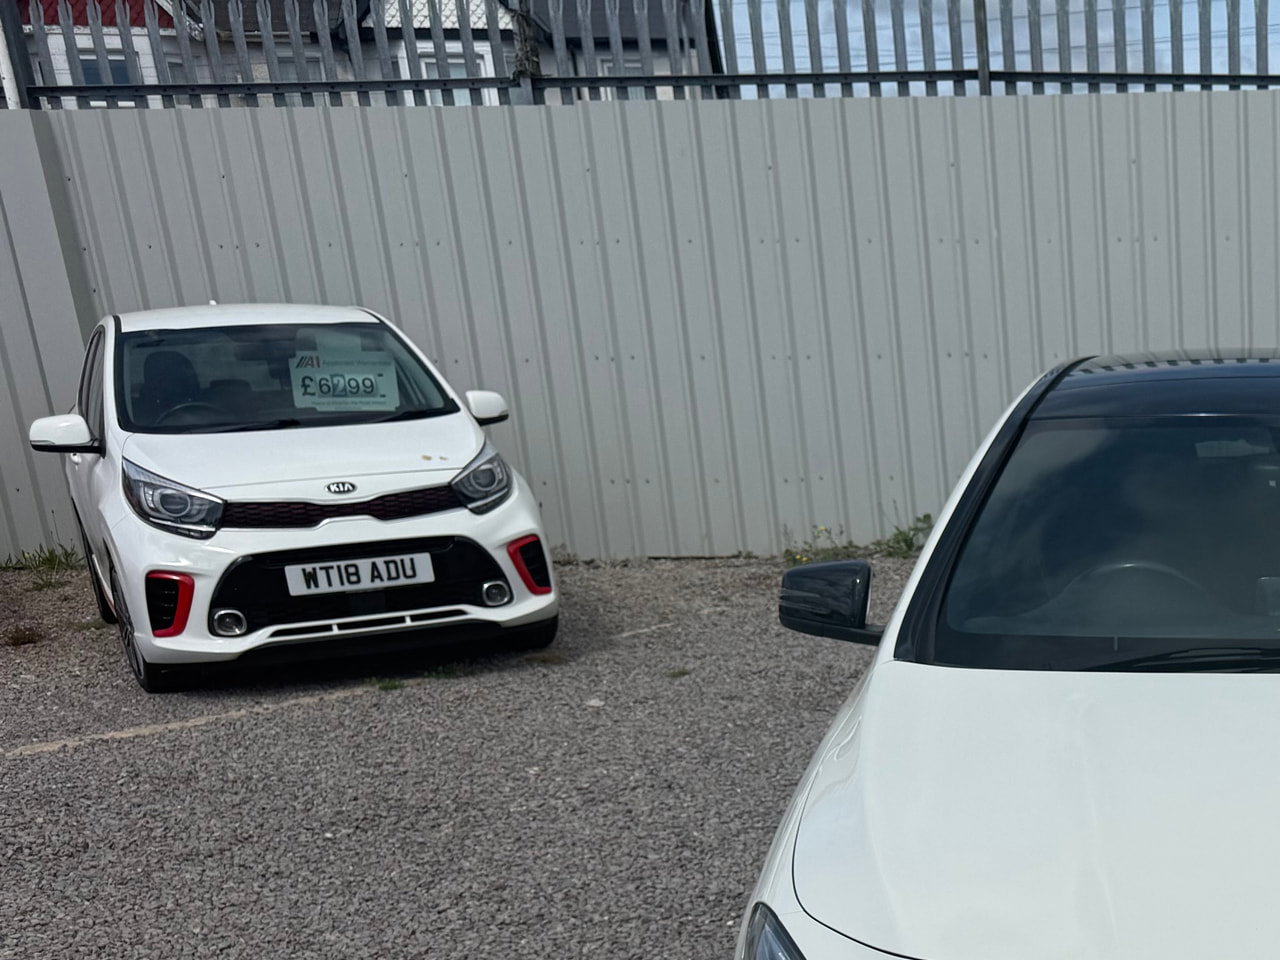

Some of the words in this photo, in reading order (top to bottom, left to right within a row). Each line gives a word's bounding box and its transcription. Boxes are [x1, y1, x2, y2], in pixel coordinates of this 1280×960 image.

[329, 483, 352, 493] KIA
[302, 563, 361, 590] WT18
[371, 557, 417, 583] ADU
